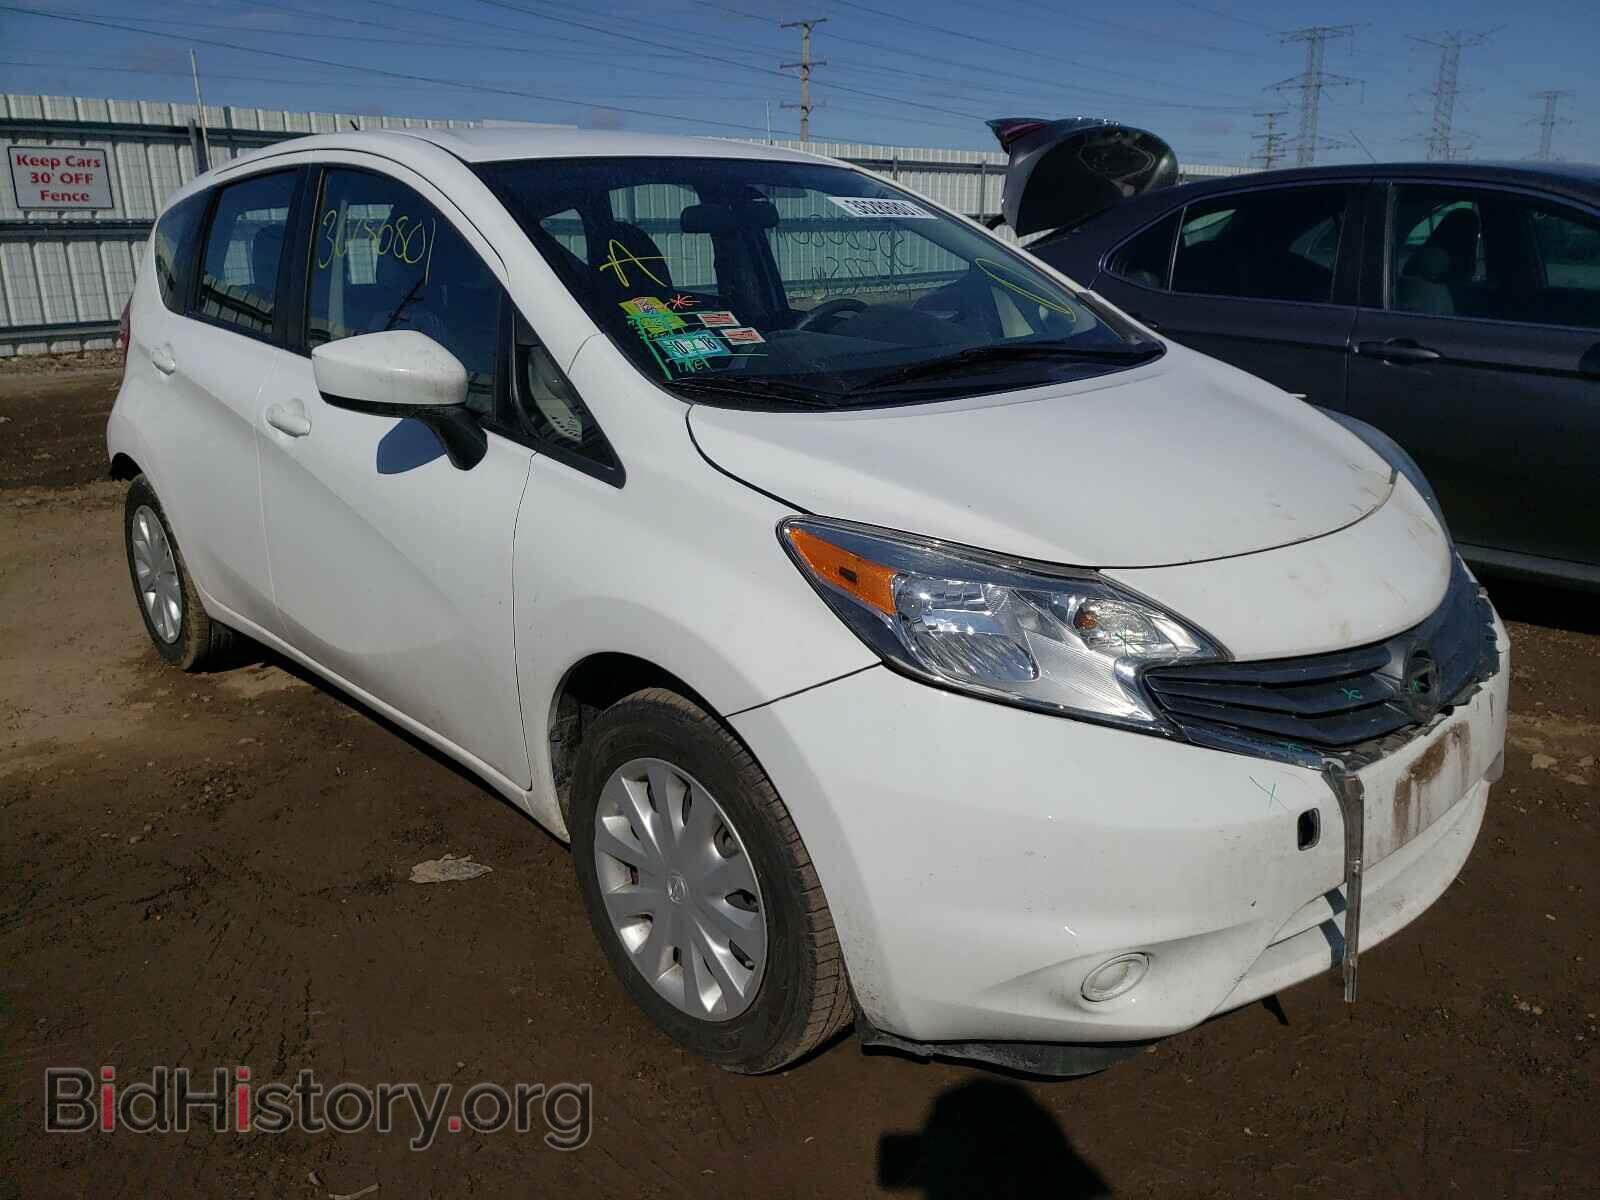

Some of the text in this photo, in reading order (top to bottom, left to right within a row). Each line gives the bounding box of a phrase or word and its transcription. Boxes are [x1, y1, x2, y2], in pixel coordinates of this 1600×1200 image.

[16, 154, 101, 171] Keep Cars
[60, 172, 94, 184] OFF
[40, 190, 90, 202] Fence
